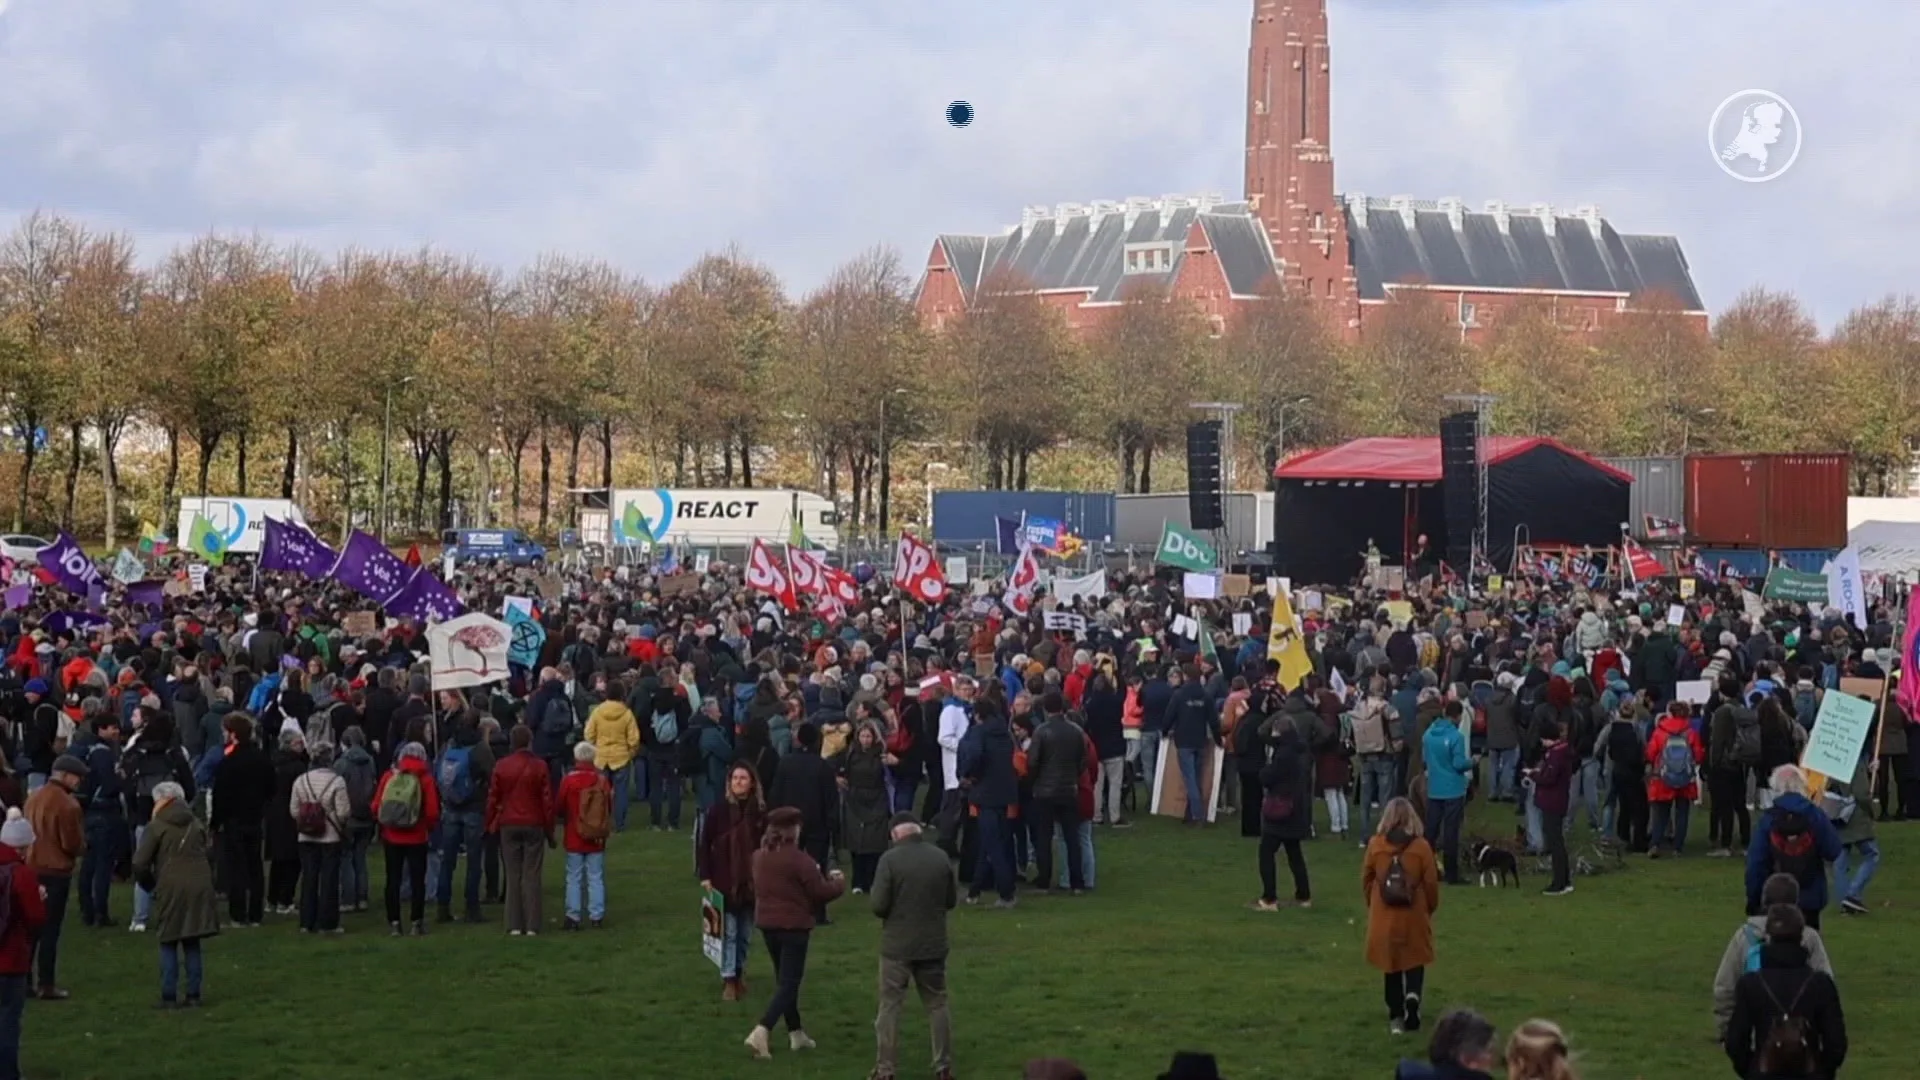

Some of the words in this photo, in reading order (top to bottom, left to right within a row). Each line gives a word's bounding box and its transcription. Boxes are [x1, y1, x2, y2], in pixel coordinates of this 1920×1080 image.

[677, 501, 759, 518] REACT
[896, 538, 931, 588] SP
[1840, 566, 1848, 575] A
